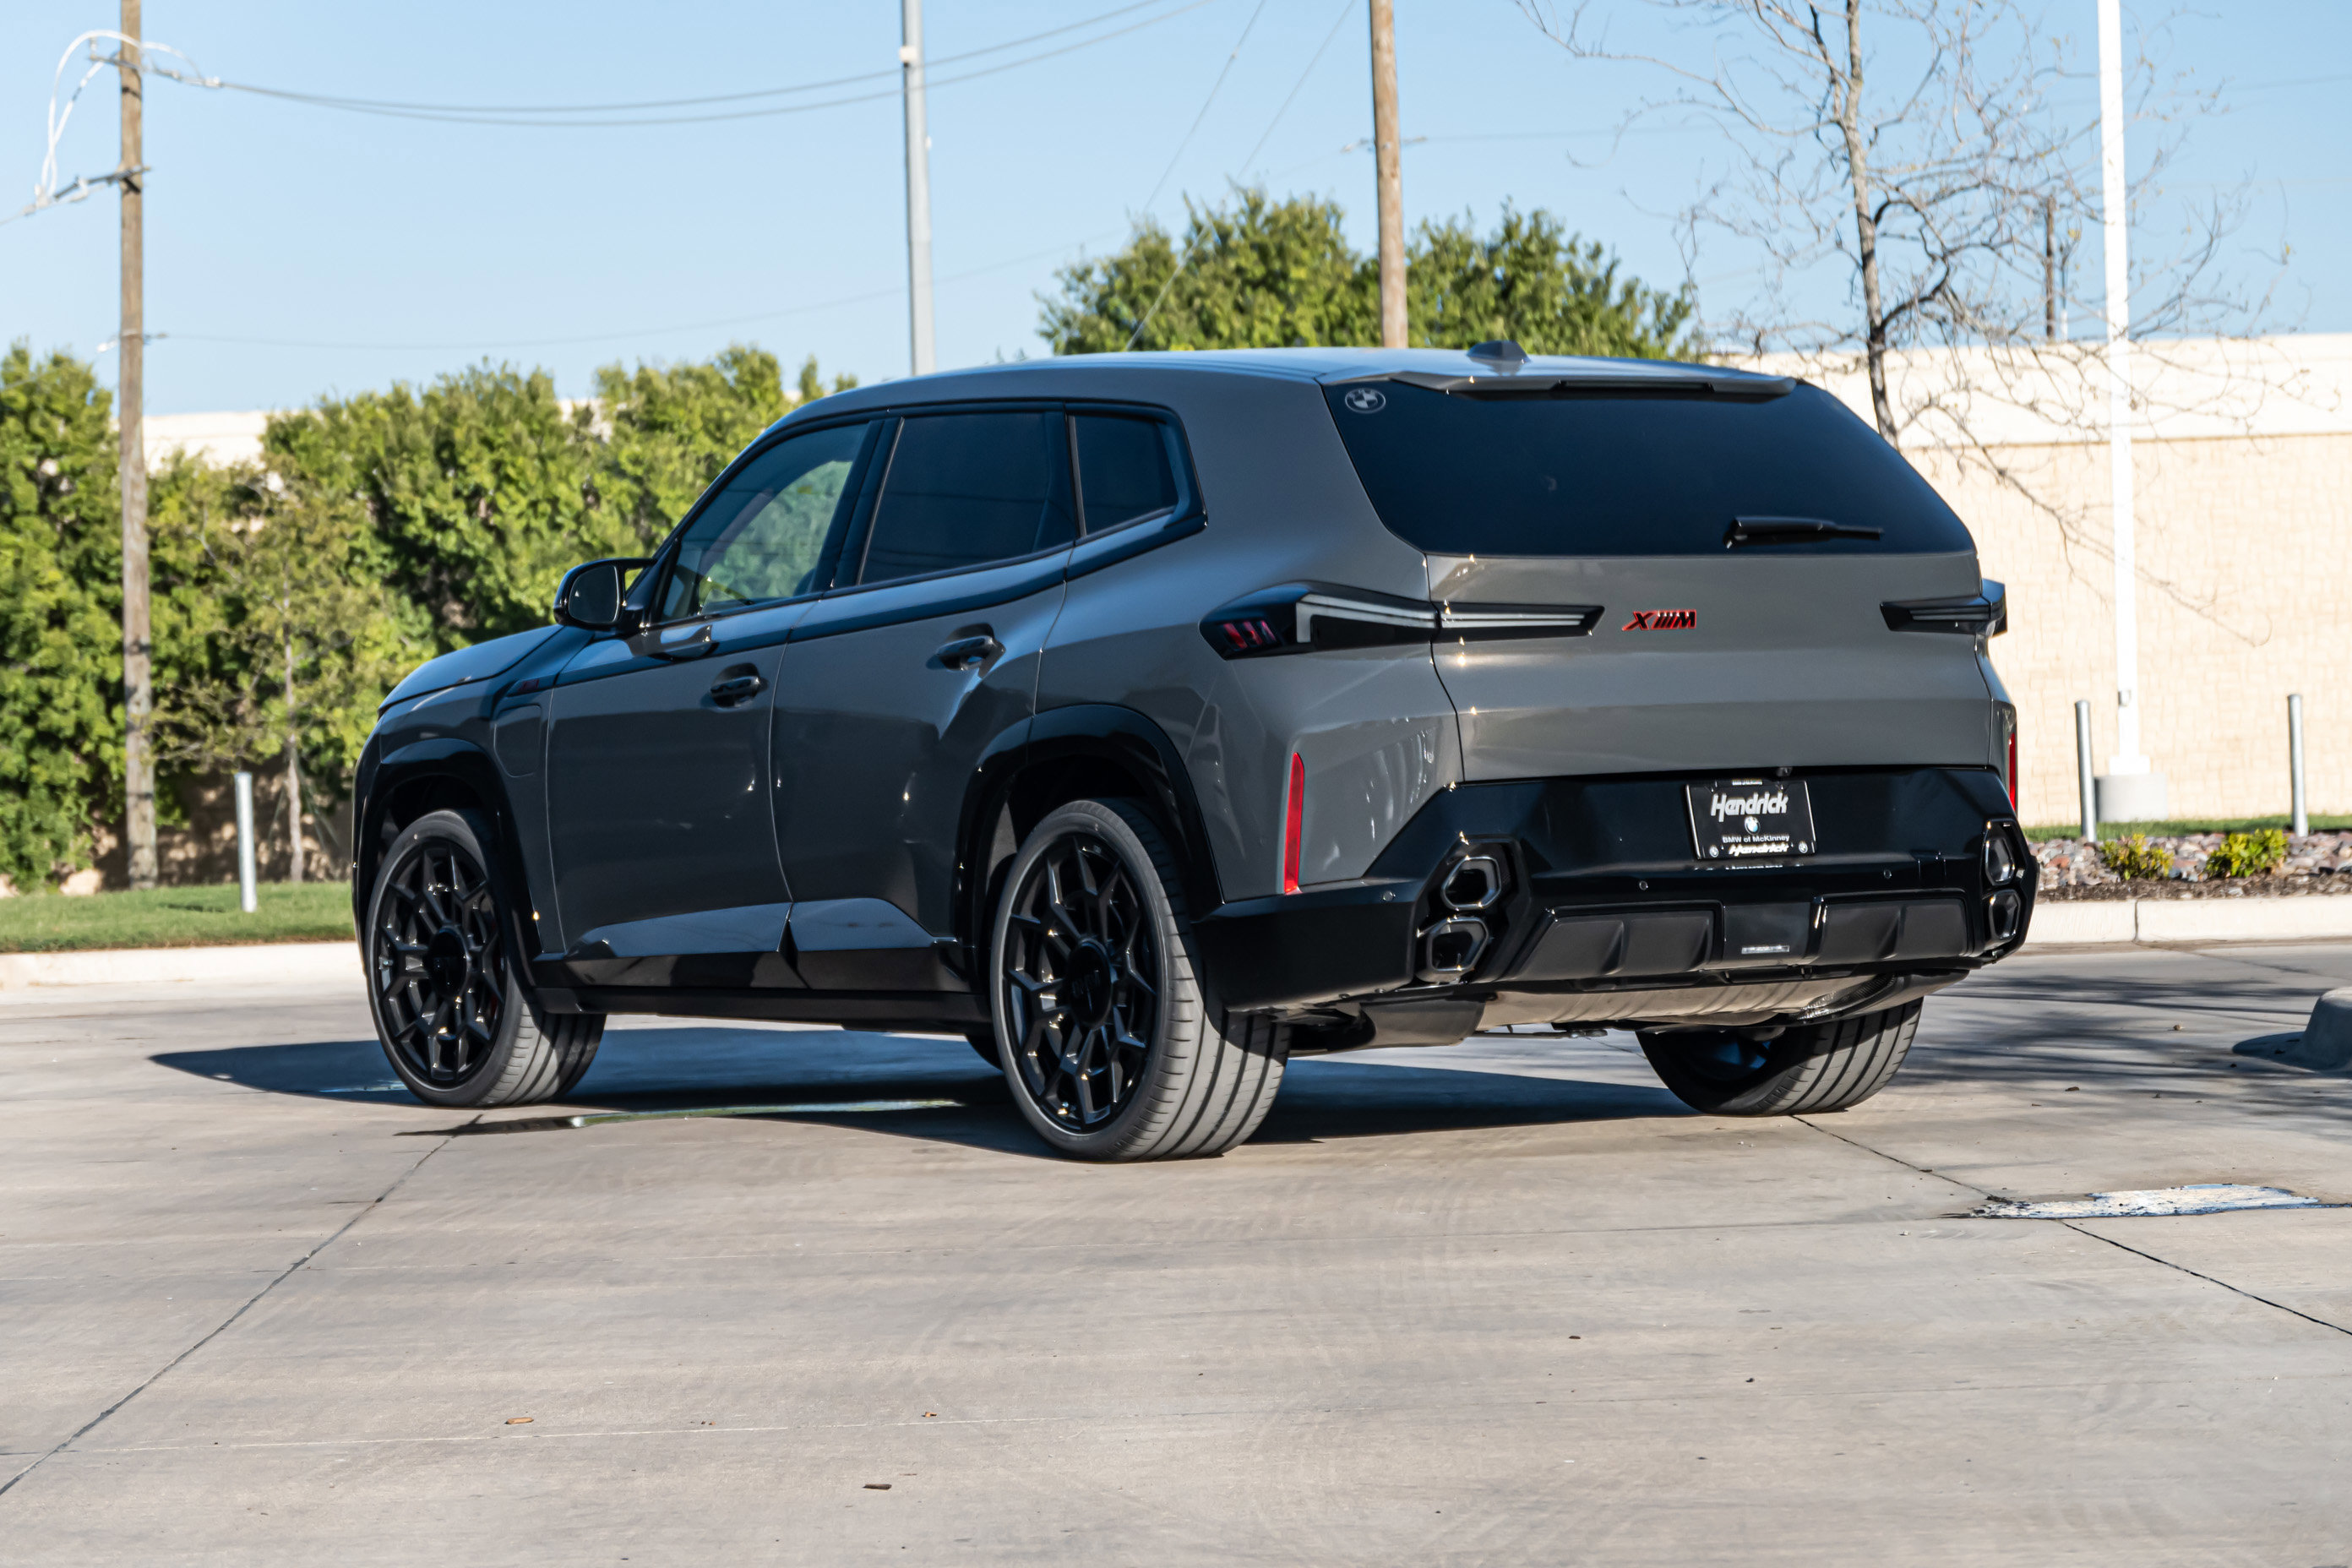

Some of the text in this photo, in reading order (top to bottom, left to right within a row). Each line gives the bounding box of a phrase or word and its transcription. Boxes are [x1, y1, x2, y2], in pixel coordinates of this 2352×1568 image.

[1711, 791, 1789, 823] Hendrick
[1723, 833, 1790, 843] BMW of McKinney
[1729, 841, 1789, 857] Hendrick
